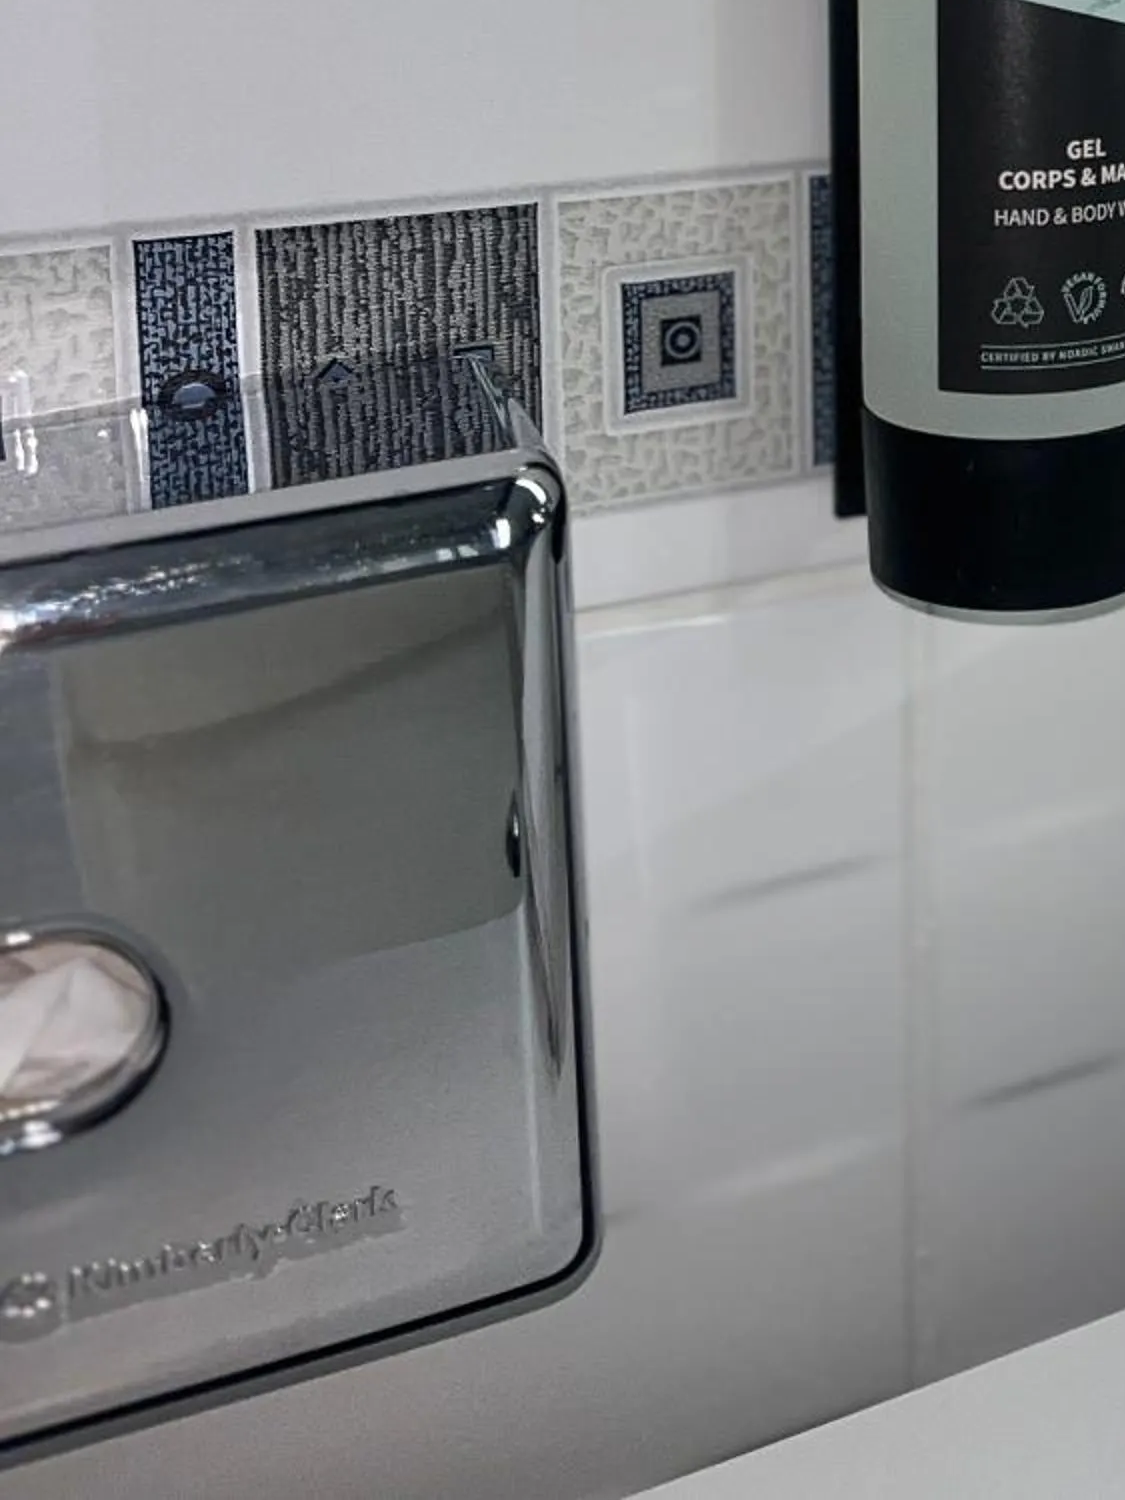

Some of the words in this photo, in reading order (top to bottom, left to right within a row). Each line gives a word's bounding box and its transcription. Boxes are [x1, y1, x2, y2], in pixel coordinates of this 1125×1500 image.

[1066, 138, 1107, 160] GEL
[998, 169, 1077, 191] CORPS
[1081, 167, 1097, 187] &
[994, 208, 1050, 227] HAND
[1053, 207, 1068, 225] &
[1071, 203, 1117, 224] BODY
[980, 351, 1039, 363] CERTIFIED
[1042, 350, 1057, 363] BY
